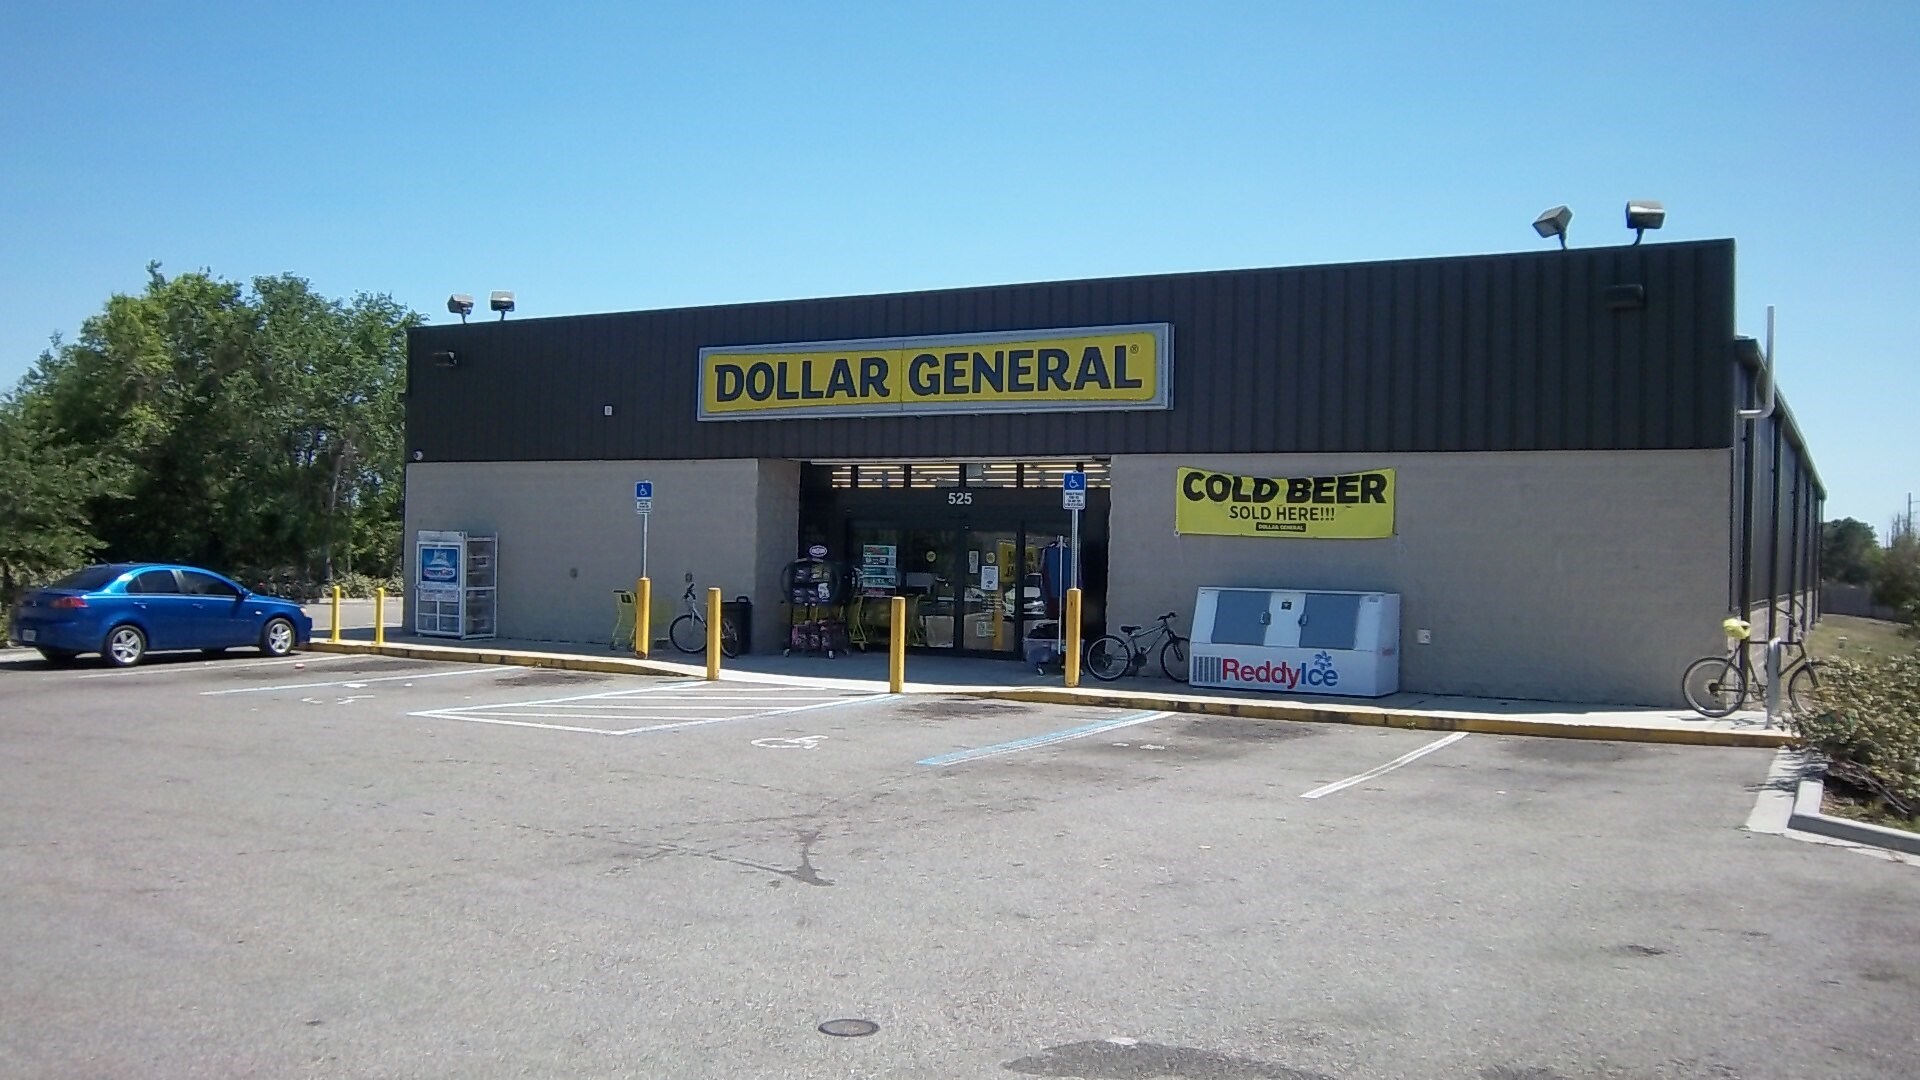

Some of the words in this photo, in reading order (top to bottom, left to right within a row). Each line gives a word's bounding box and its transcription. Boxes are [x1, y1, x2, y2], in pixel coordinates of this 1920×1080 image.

[714, 356, 890, 402] DOLLAR
[947, 492, 973, 505] 525
[1183, 471, 1280, 504] COLD
[1286, 473, 1388, 504] BEER
[1229, 505, 1272, 520] SOLD
[1276, 505, 1335, 521] HERE!!!
